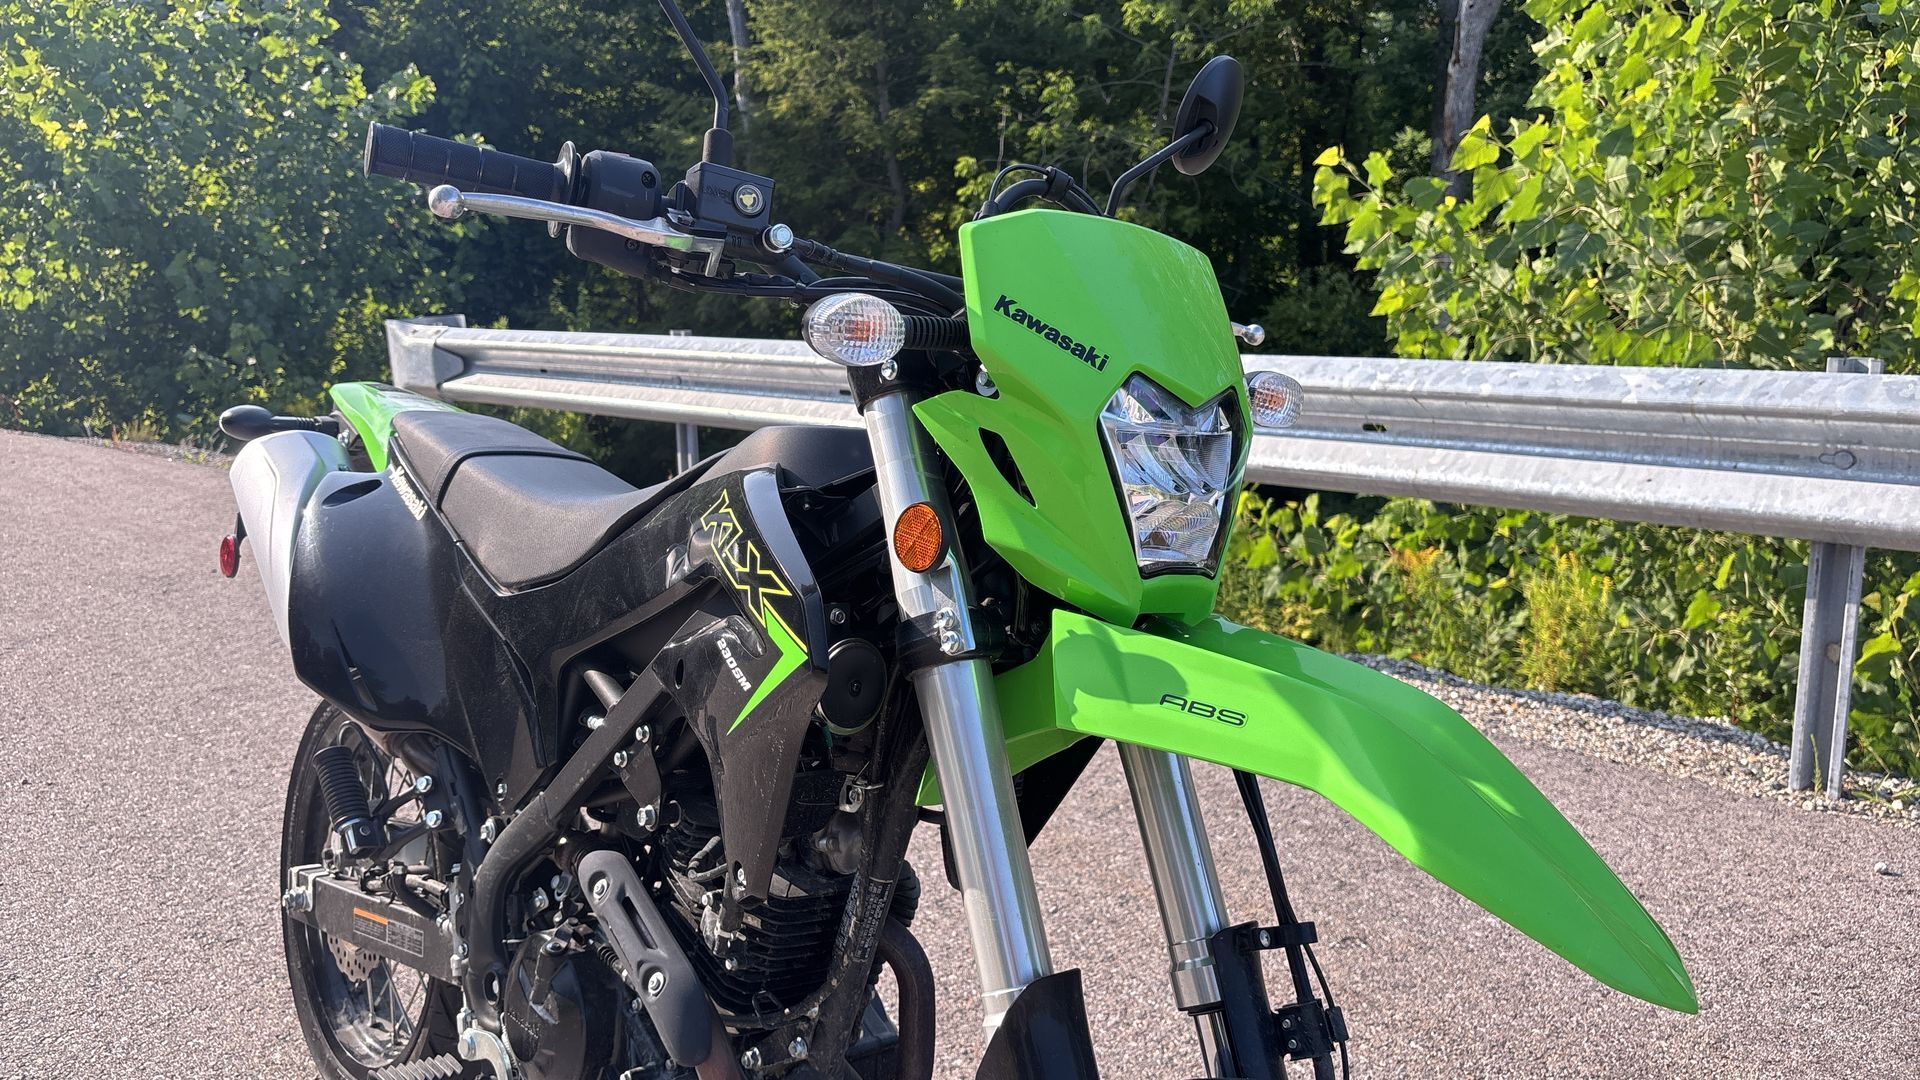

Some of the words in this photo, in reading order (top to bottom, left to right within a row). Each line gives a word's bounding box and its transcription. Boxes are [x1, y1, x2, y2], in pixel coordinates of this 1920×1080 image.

[994, 294, 1109, 371] Kawasaki
[388, 463, 428, 521] Kawasaki
[700, 489, 793, 628] KLX
[717, 637, 752, 691] 230SM
[1159, 693, 1246, 726] ABS
